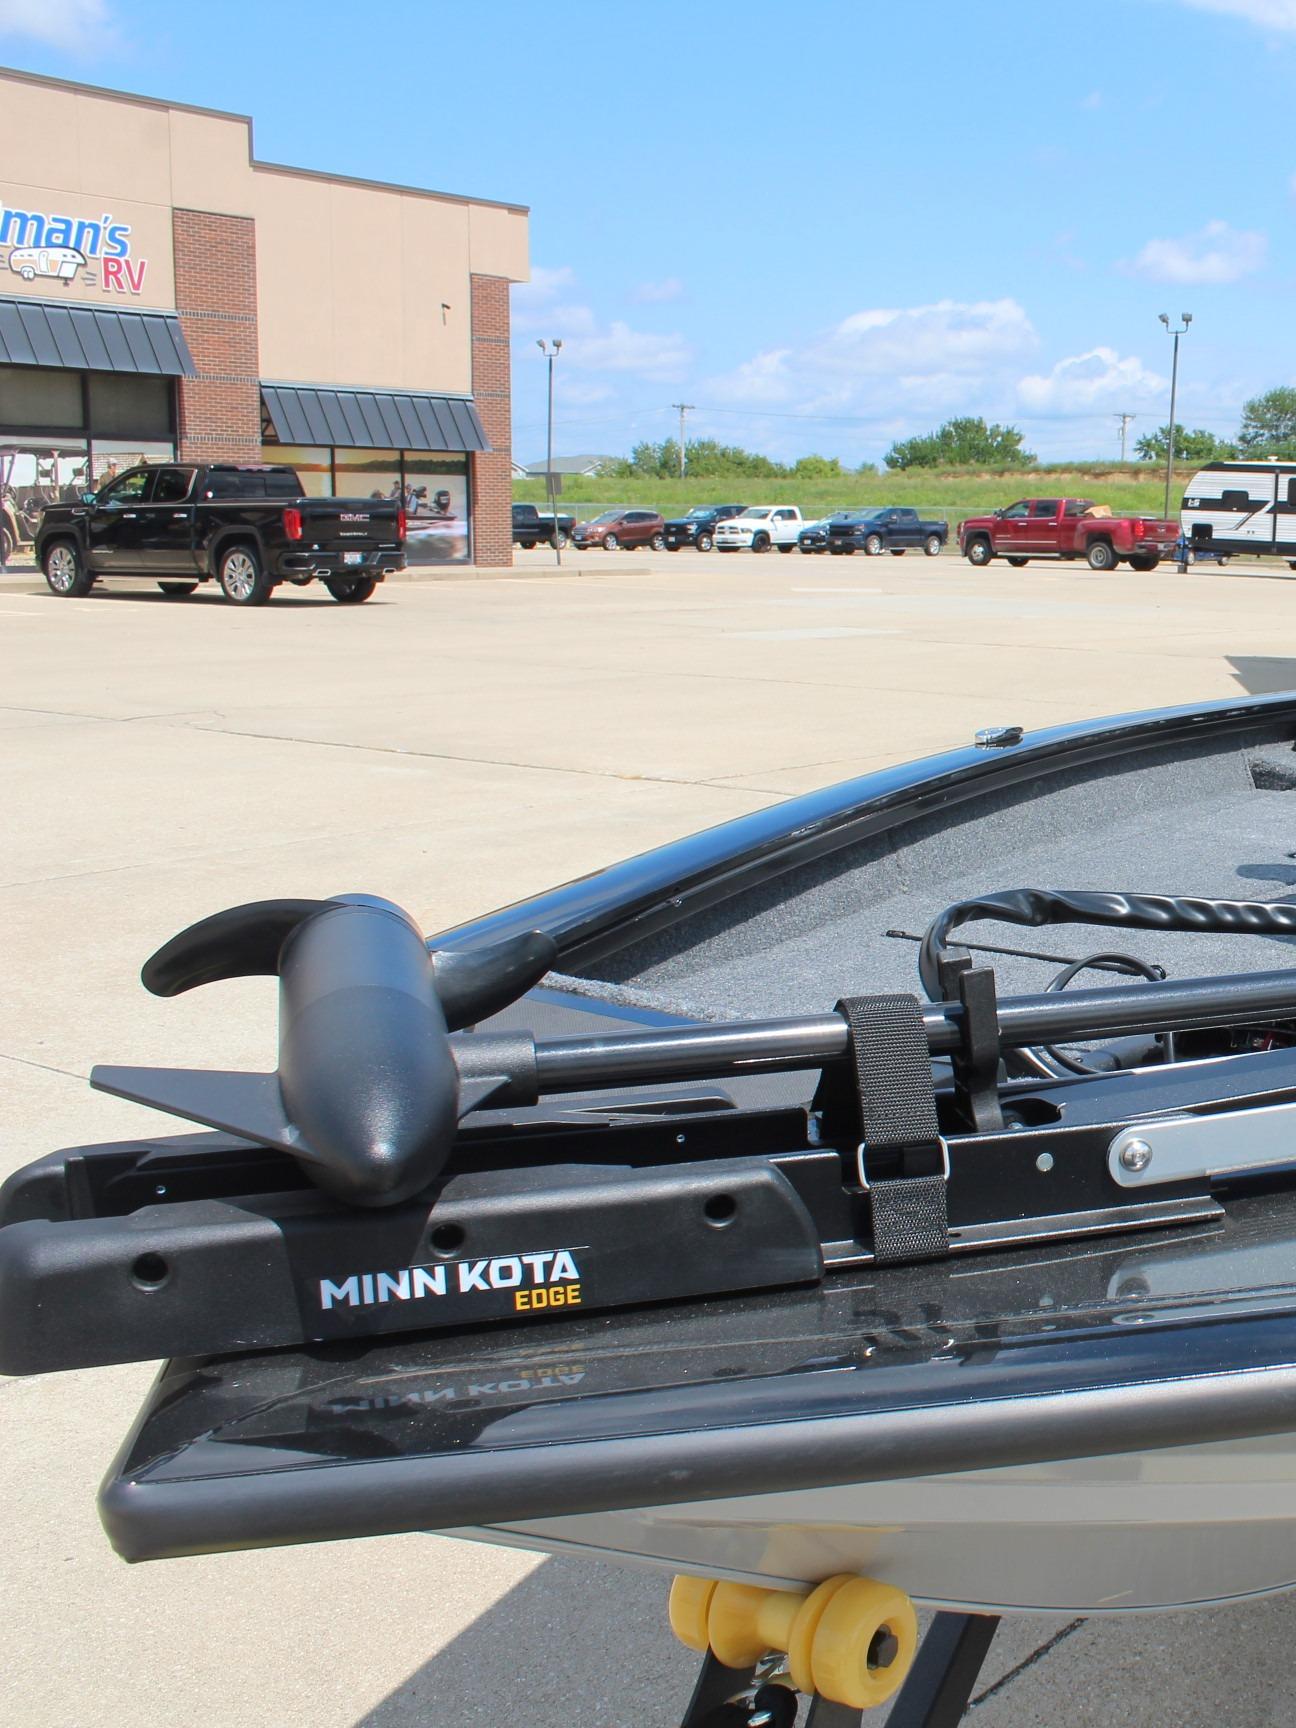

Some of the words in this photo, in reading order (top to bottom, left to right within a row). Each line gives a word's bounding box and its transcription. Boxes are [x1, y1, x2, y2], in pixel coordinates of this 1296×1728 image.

[102, 256, 147, 292] RV
[320, 1265, 447, 1310] MINN
[459, 1251, 580, 1293] KOTA
[515, 1284, 582, 1311] EDGE
